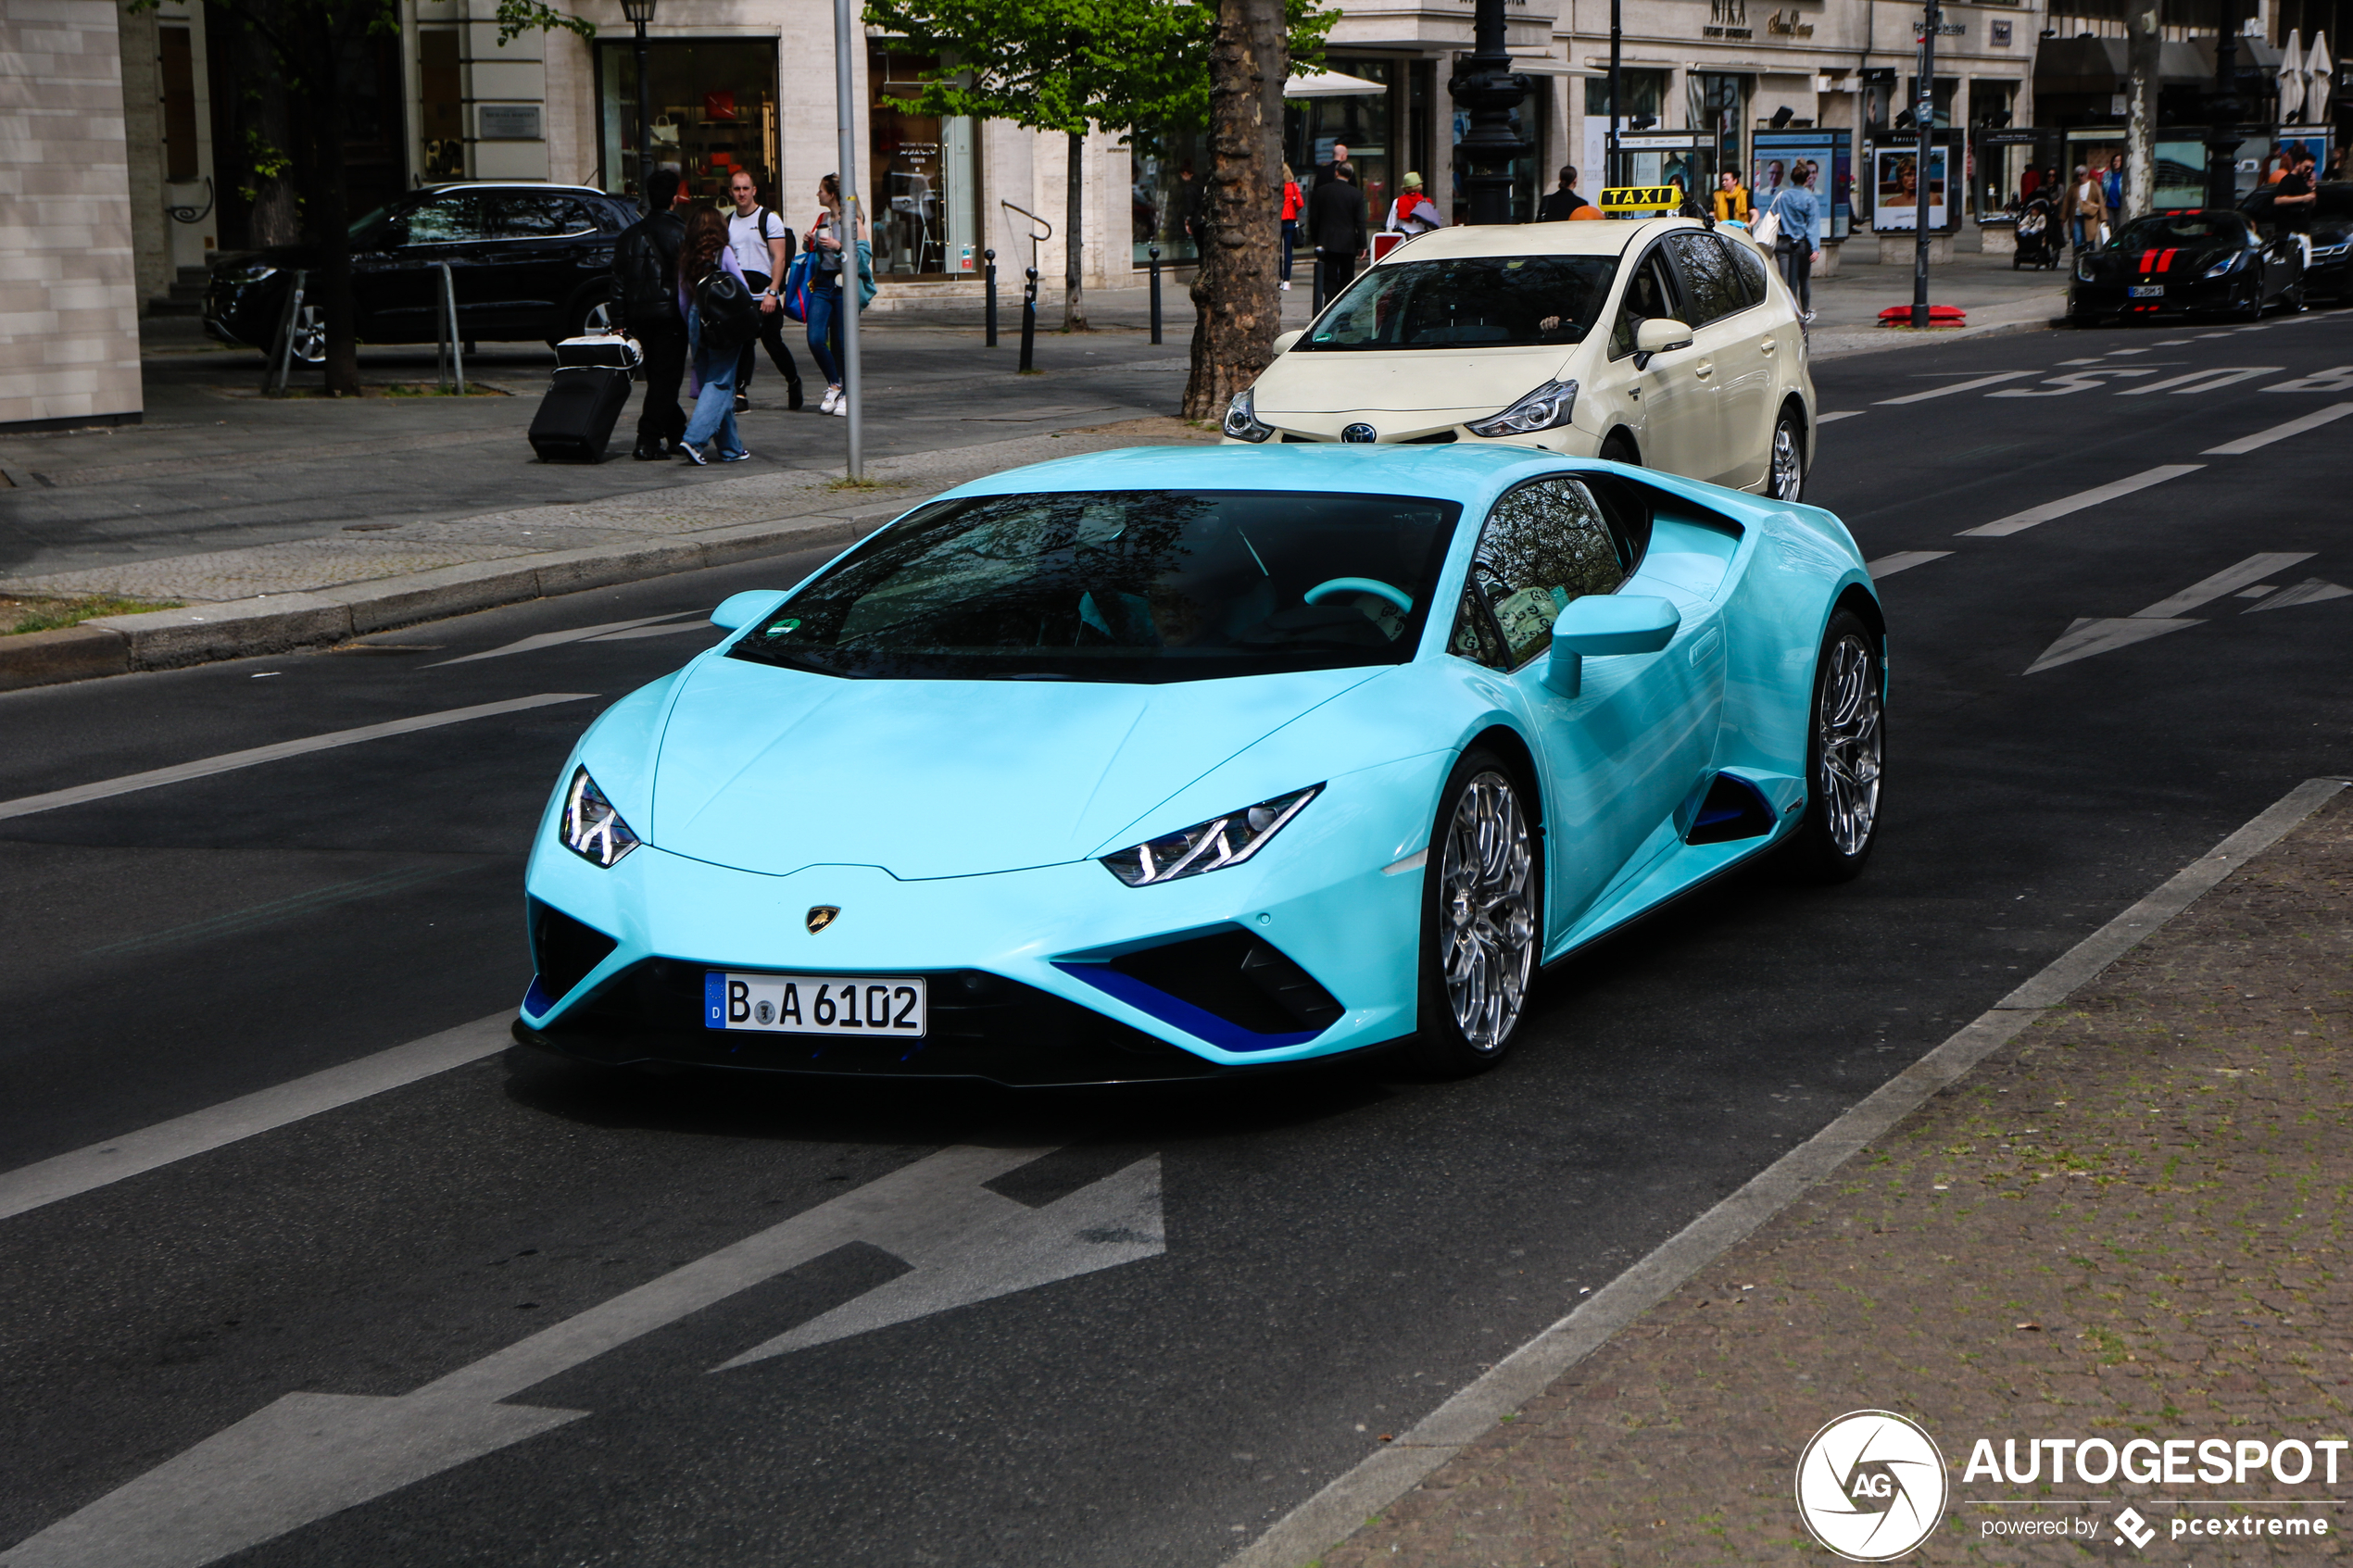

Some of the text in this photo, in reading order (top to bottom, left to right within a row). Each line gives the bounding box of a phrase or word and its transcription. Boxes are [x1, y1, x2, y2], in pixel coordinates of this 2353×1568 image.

[1610, 189, 1663, 204] TAXI
[728, 980, 917, 1029] B A 6102
[711, 1006, 720, 1019] D
